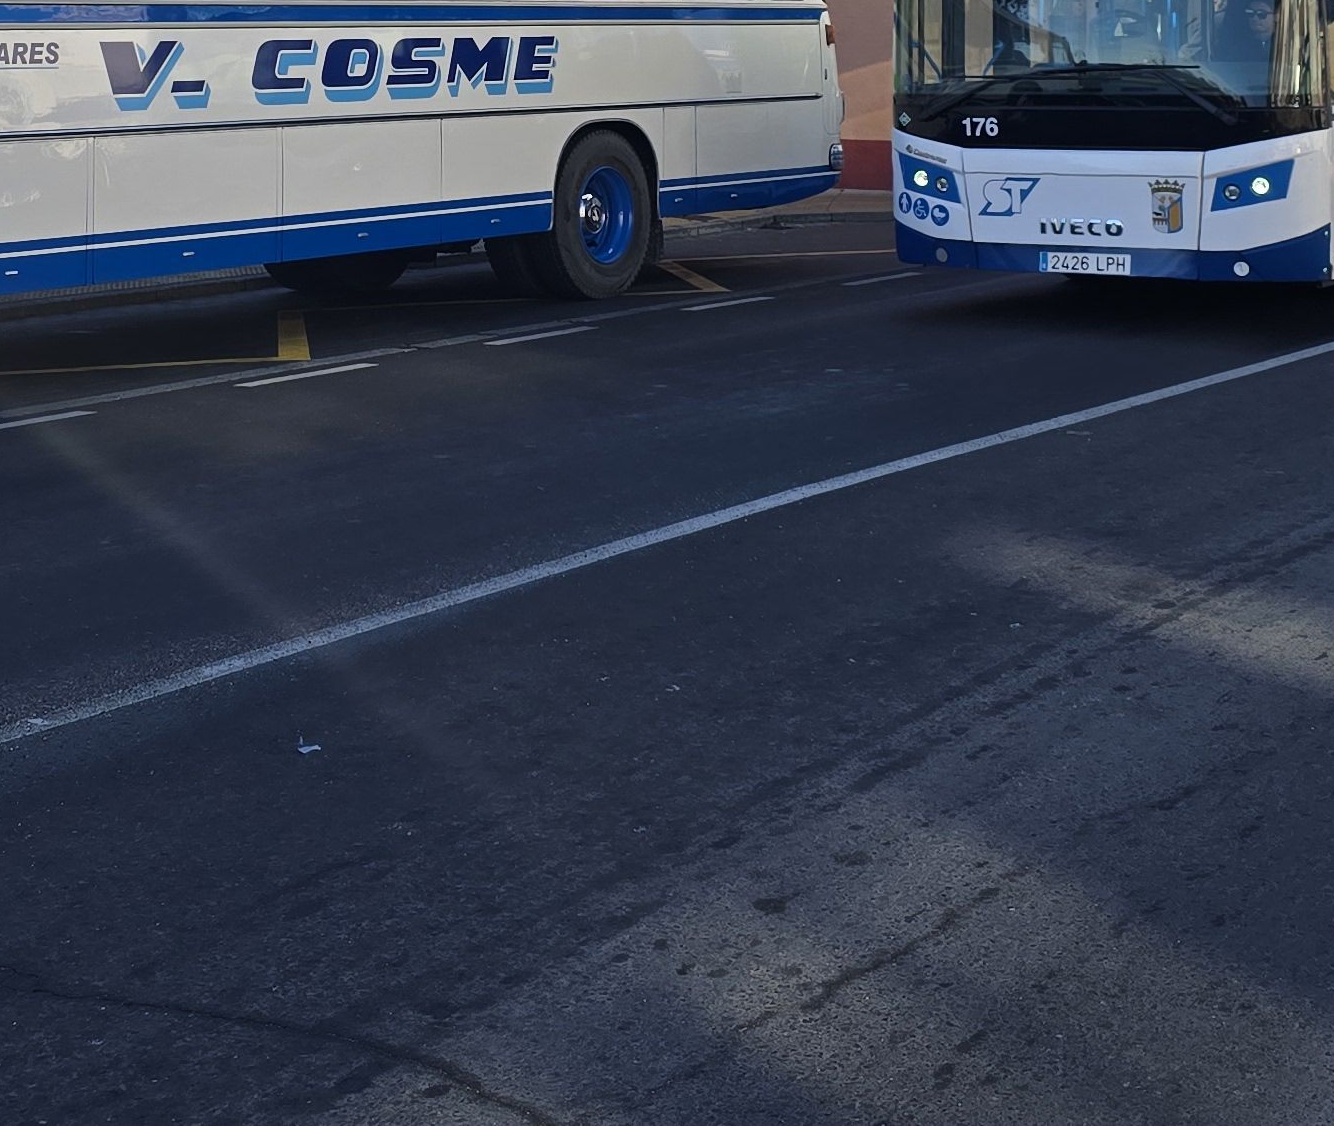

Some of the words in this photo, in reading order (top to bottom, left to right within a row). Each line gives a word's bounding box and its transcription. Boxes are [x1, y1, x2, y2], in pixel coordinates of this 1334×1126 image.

[252, 36, 558, 106] COSME
[962, 117, 999, 137] 176
[978, 177, 1041, 216] ST
[1039, 218, 1124, 236] IVECO
[1051, 255, 1090, 271] 2426
[1096, 257, 1126, 272] LPH
